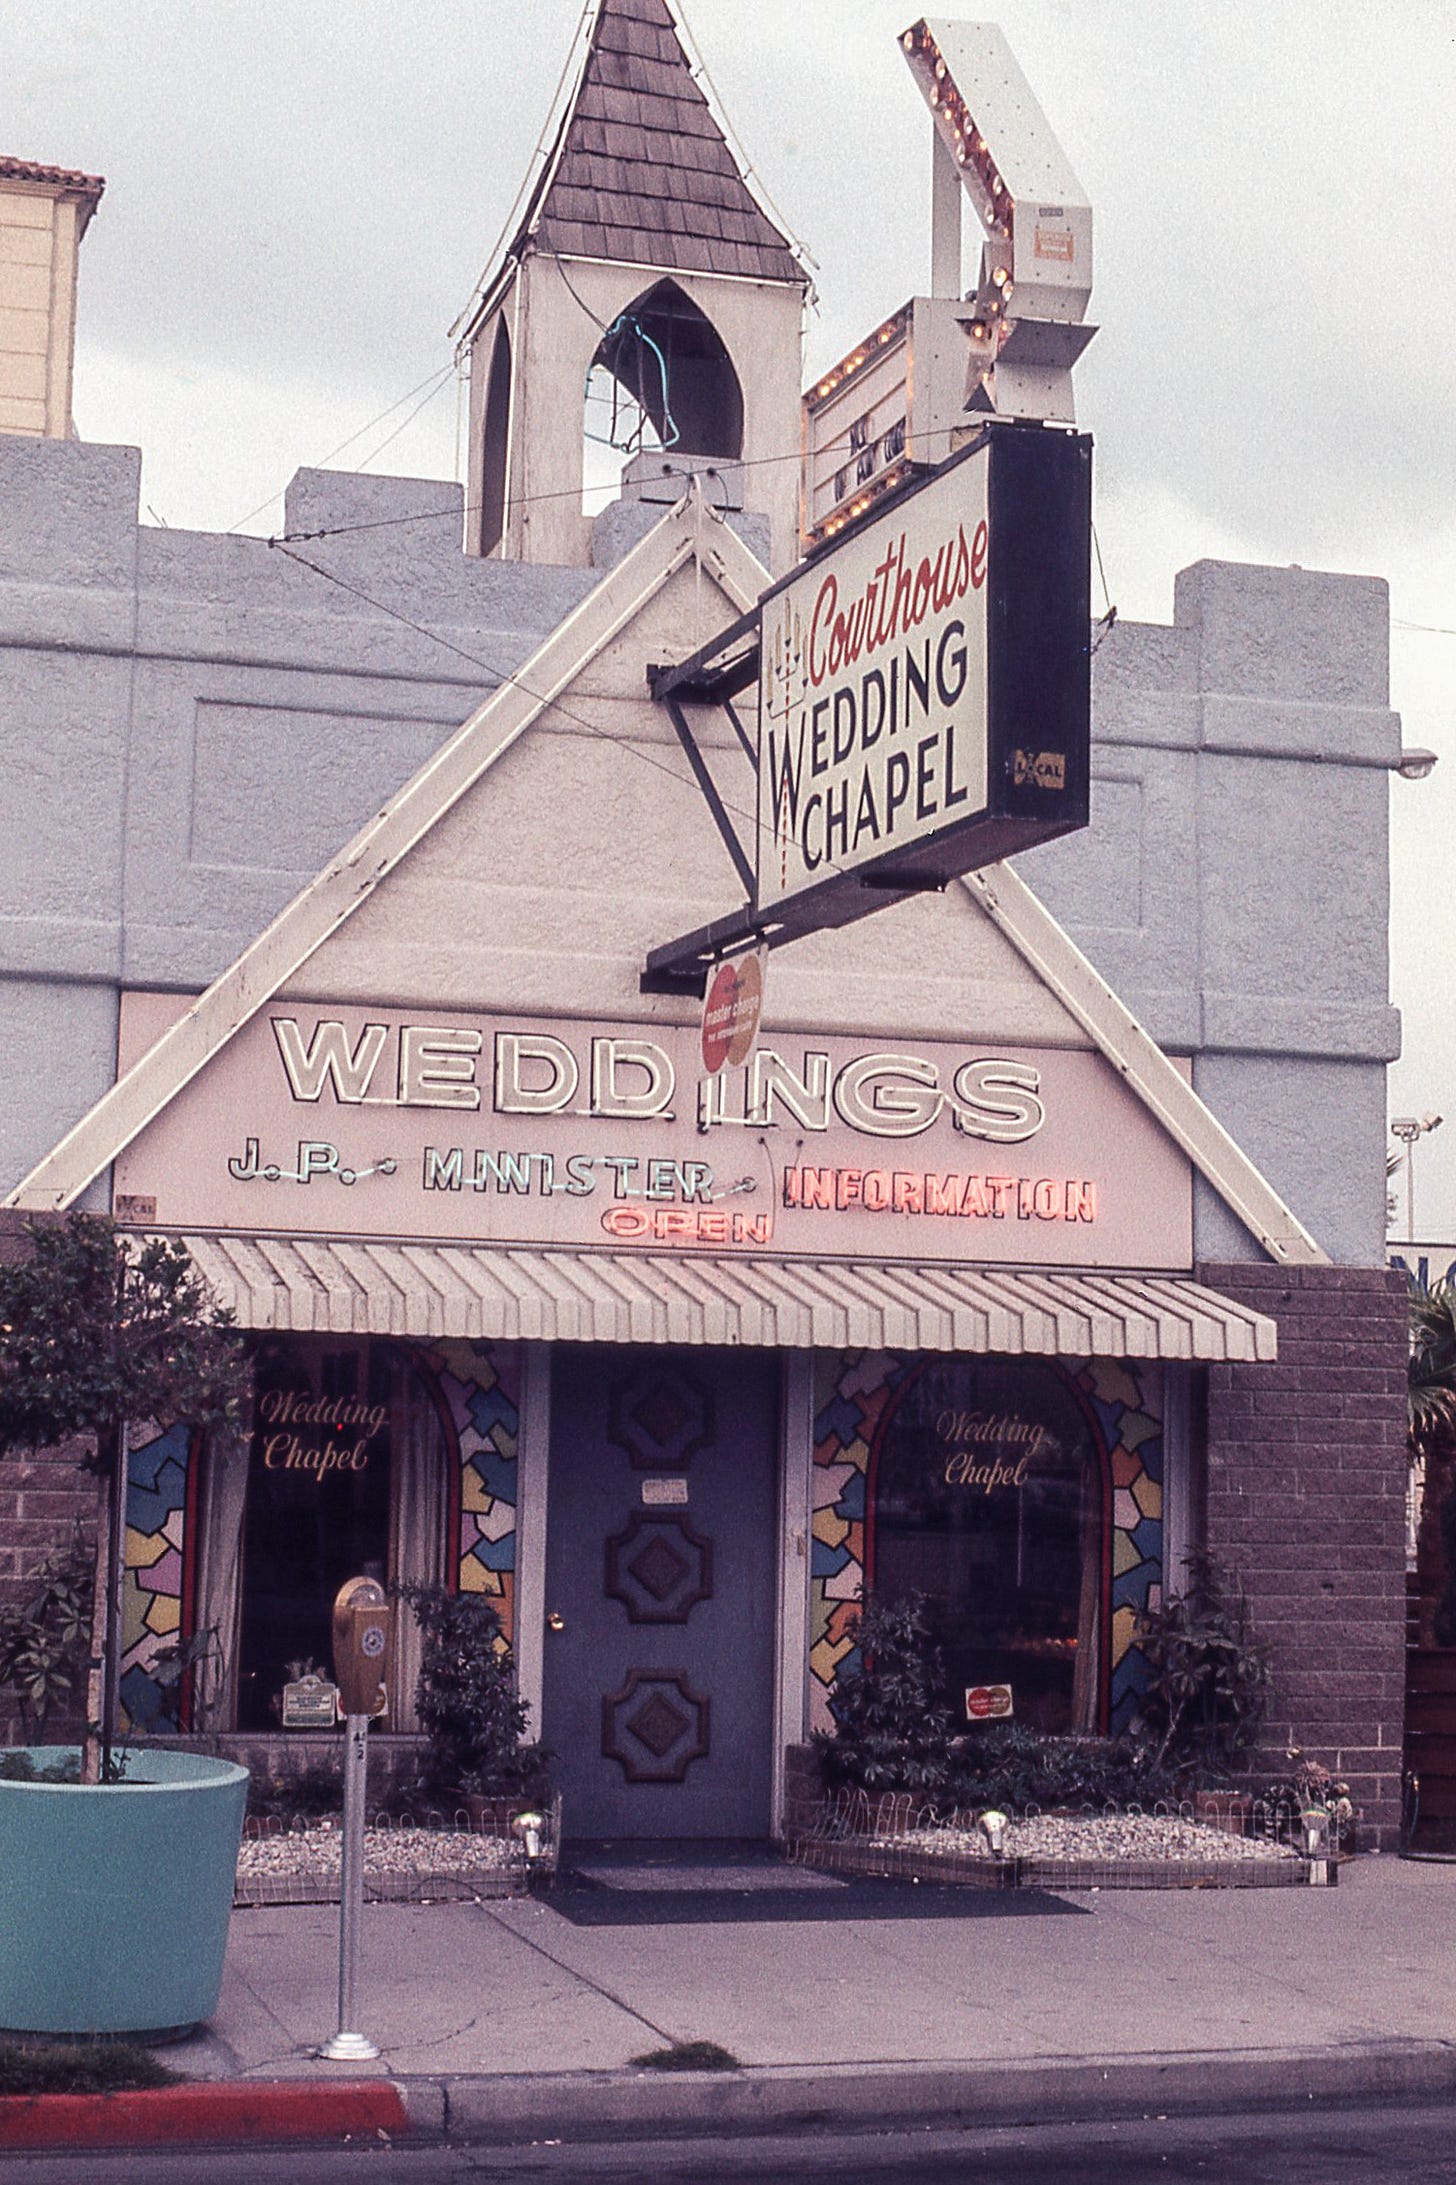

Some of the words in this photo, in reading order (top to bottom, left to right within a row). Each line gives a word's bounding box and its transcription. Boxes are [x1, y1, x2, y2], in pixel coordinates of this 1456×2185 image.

[808, 519, 989, 688] Courthouse
[768, 618, 968, 849] WEDDING
[801, 725, 968, 871] CHAPEL
[270, 1015, 1046, 1144] WEDDINGS
[423, 1147, 714, 1204] MINISTER
[783, 1164, 1098, 1224] INFORMATION
[600, 1206, 770, 1245] OPEN
[260, 1389, 389, 1439] Wedding
[936, 1409, 1053, 1456] Wedding
[263, 1432, 368, 1482] Chapel
[944, 1452, 1028, 1495] Chapel
